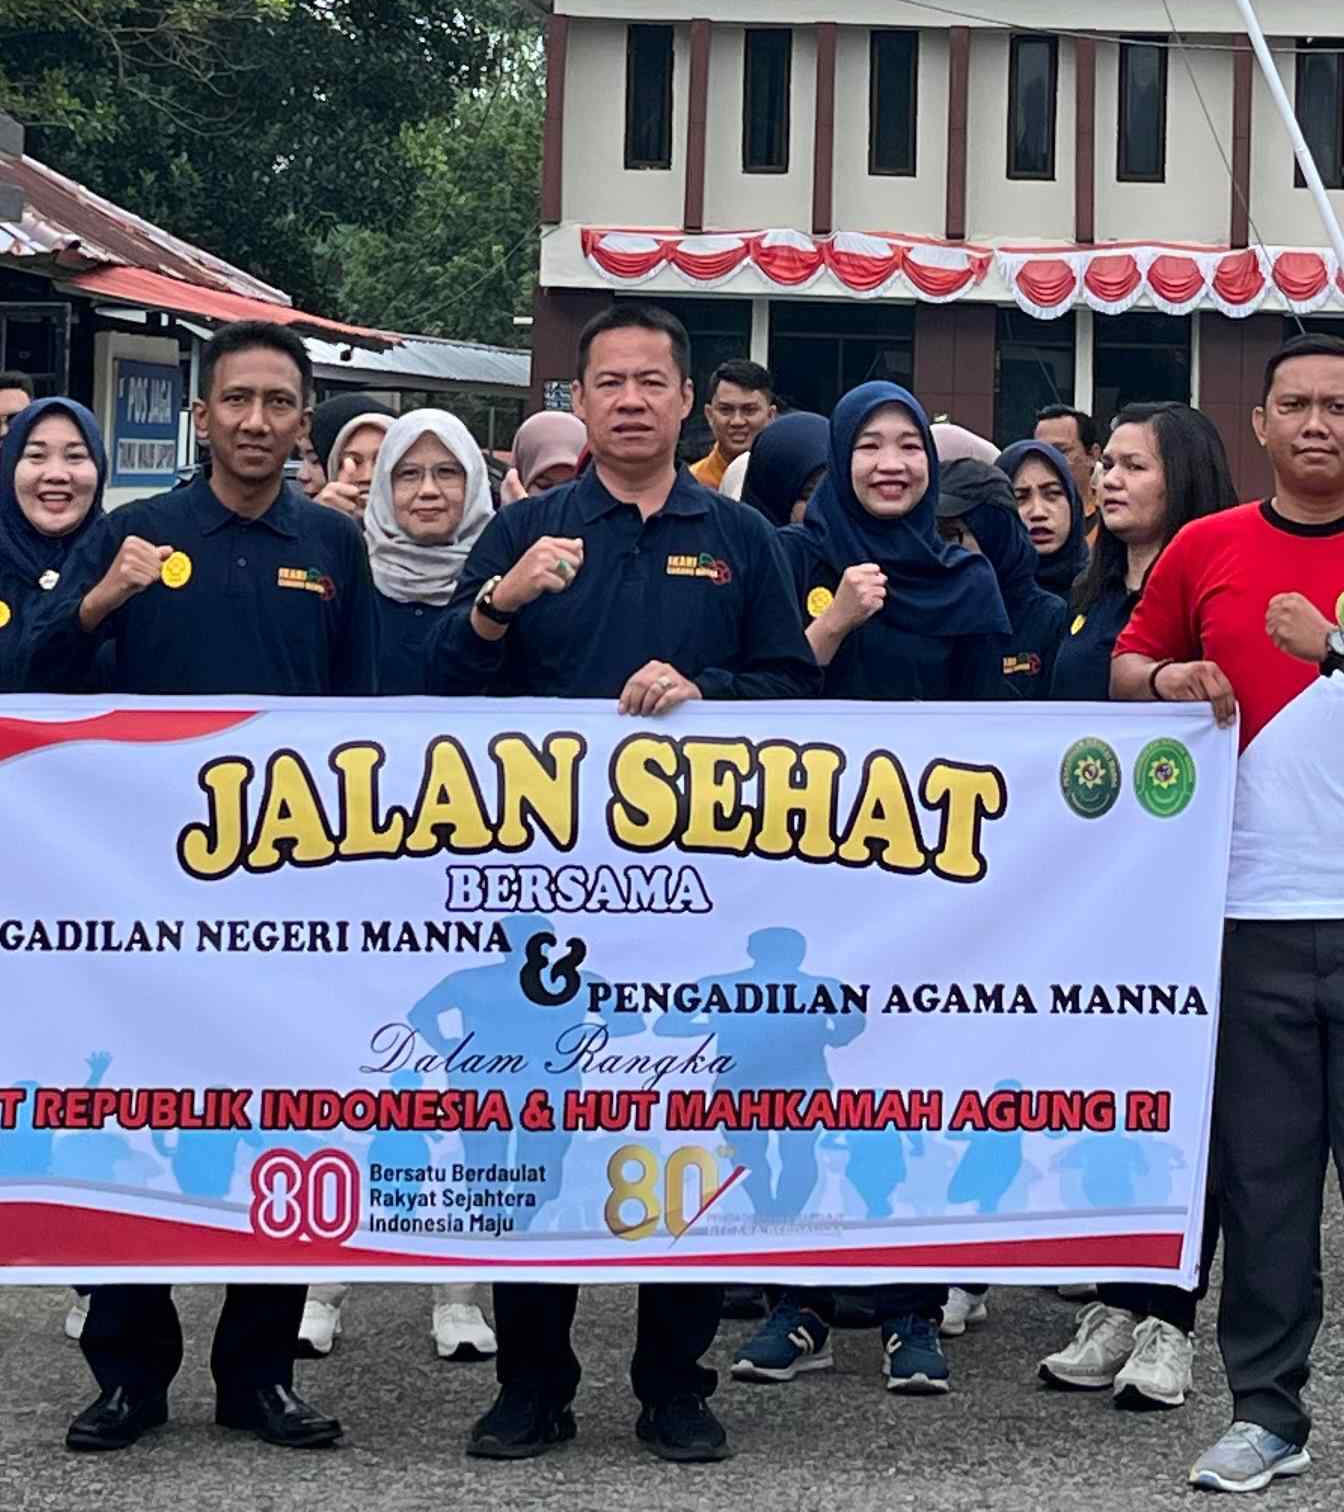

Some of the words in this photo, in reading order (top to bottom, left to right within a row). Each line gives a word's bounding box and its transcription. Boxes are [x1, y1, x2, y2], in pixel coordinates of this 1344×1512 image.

[176, 731, 587, 881] JALAN
[605, 731, 1008, 884] SEHAT
[446, 864, 713, 913] BERSAMA
[196, 920, 349, 953] NEGERI
[360, 920, 513, 953] MANNA
[519, 932, 587, 1007] &
[587, 982, 871, 1015] PENGADILAN
[881, 983, 1038, 1015] AGAMA
[1049, 984, 1209, 1016] MANNA
[358, 1022, 528, 1075] Dalam
[544, 1022, 738, 1092] Rangka
[33, 1088, 253, 1131] REPUBLIK
[259, 1089, 514, 1132] INDONESIA
[520, 1090, 555, 1132] &
[562, 1089, 660, 1132] HUT
[665, 1089, 944, 1132] MAHKAMAH
[948, 1090, 1117, 1133] AGUNG
[1124, 1091, 1172, 1132] RI
[249, 1148, 361, 1245] 80
[369, 1163, 447, 1183] Bersatu
[451, 1163, 547, 1183] Berdaulat
[604, 1144, 719, 1241] 80
[369, 1188, 443, 1212] Rakyat
[442, 1188, 537, 1213] Sejahtera
[369, 1213, 464, 1233] Indonesia
[469, 1213, 515, 1238] Maju
